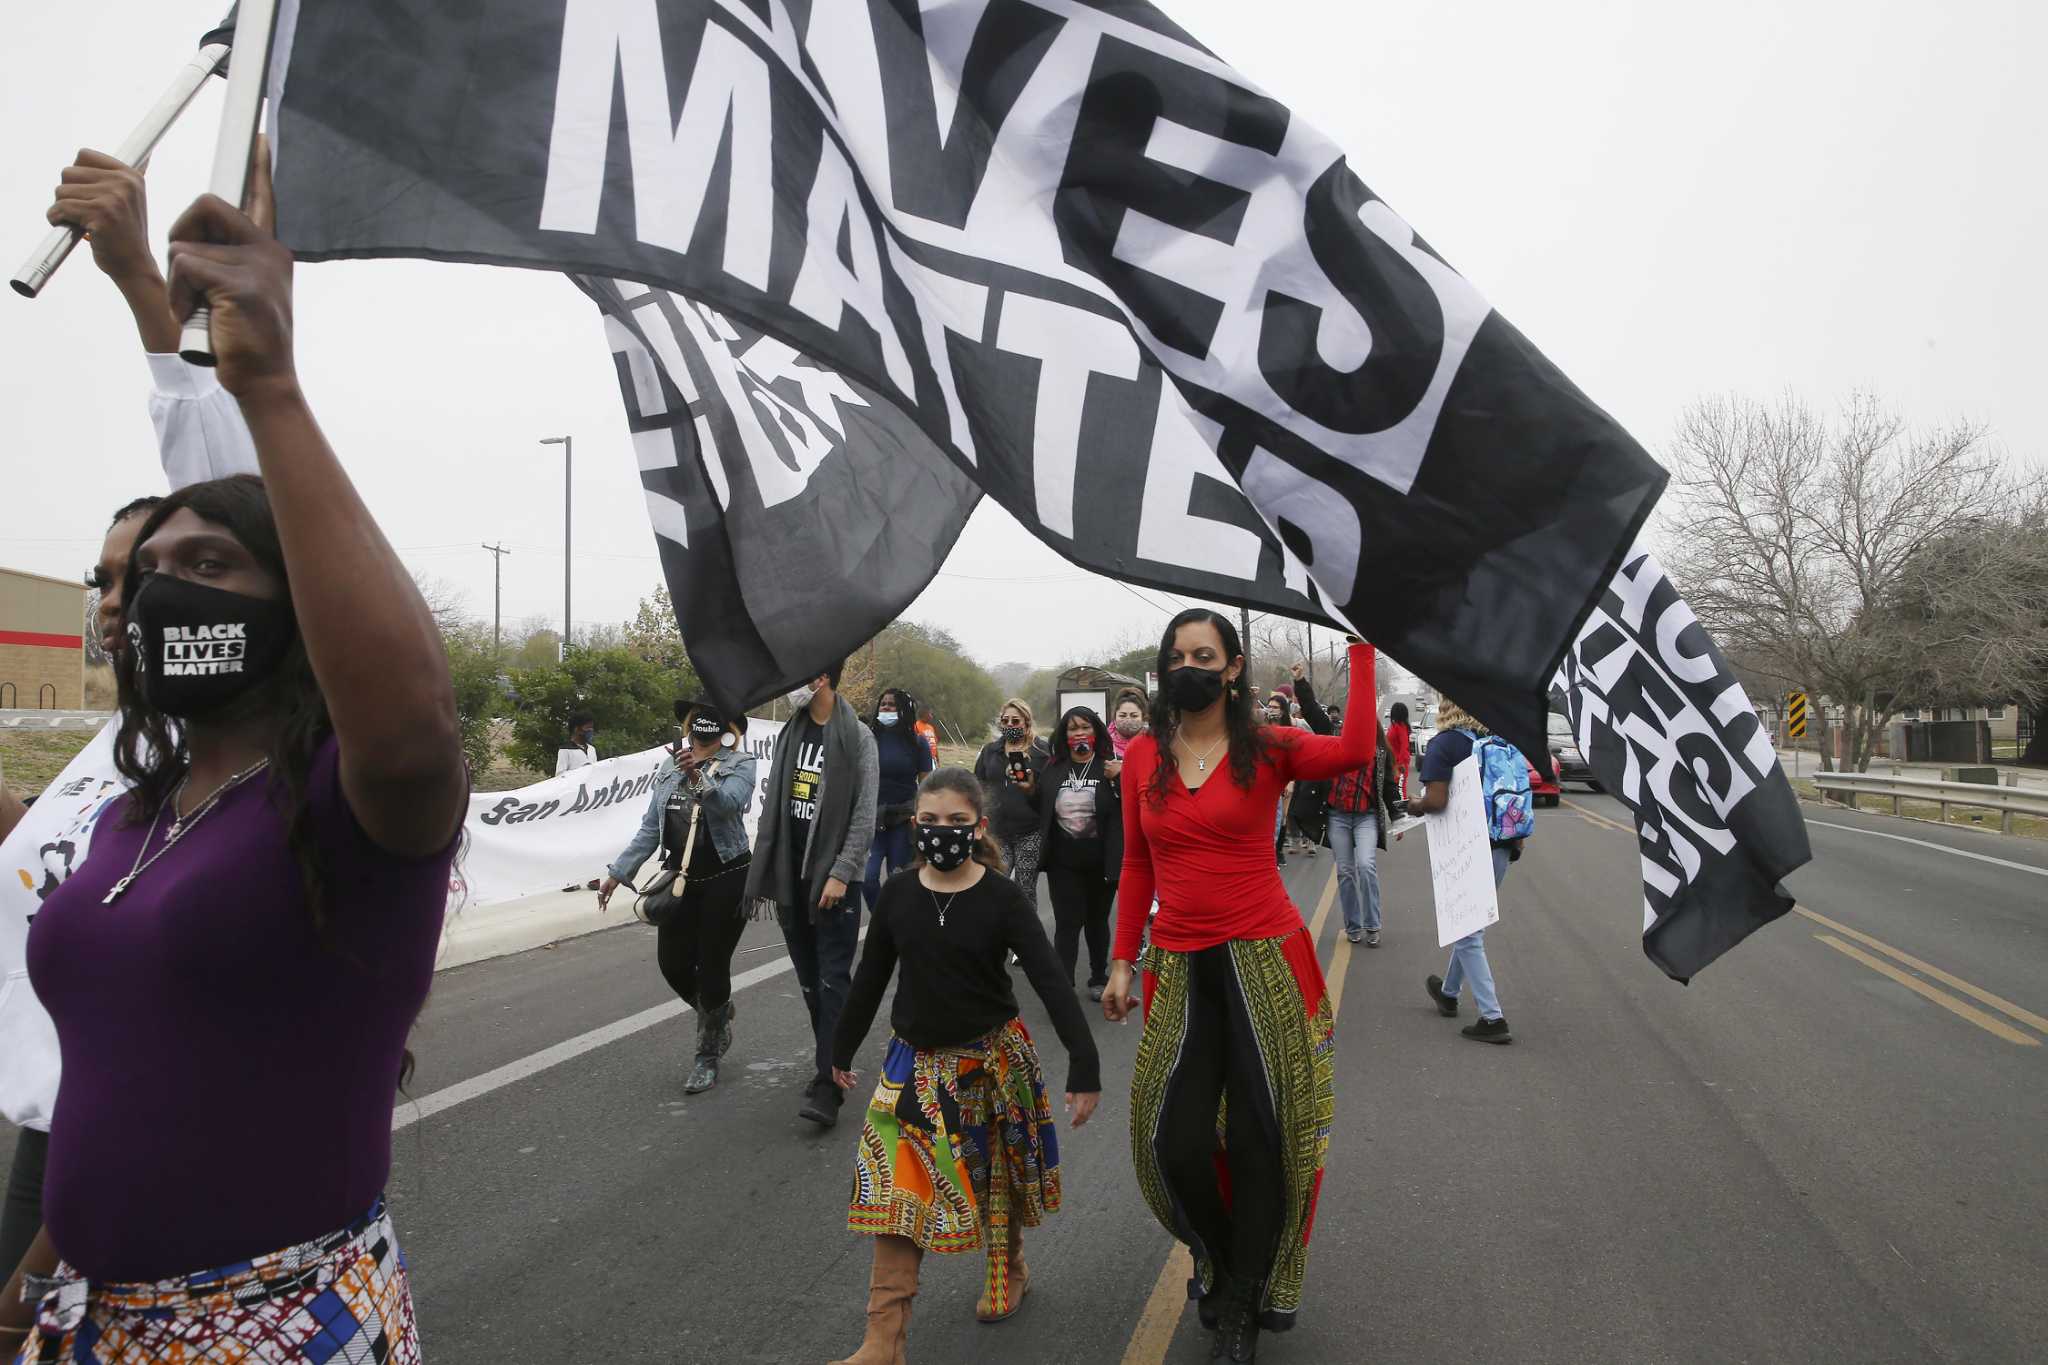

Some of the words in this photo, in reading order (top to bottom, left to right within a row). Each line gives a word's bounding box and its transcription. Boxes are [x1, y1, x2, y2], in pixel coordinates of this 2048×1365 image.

[163, 623, 247, 642] BLACK
[167, 642, 243, 660] LIVES
[163, 660, 243, 676] MATTER
[692, 723, 720, 733] Trouble
[480, 797, 561, 826] San
[558, 762, 660, 817] Antoni
